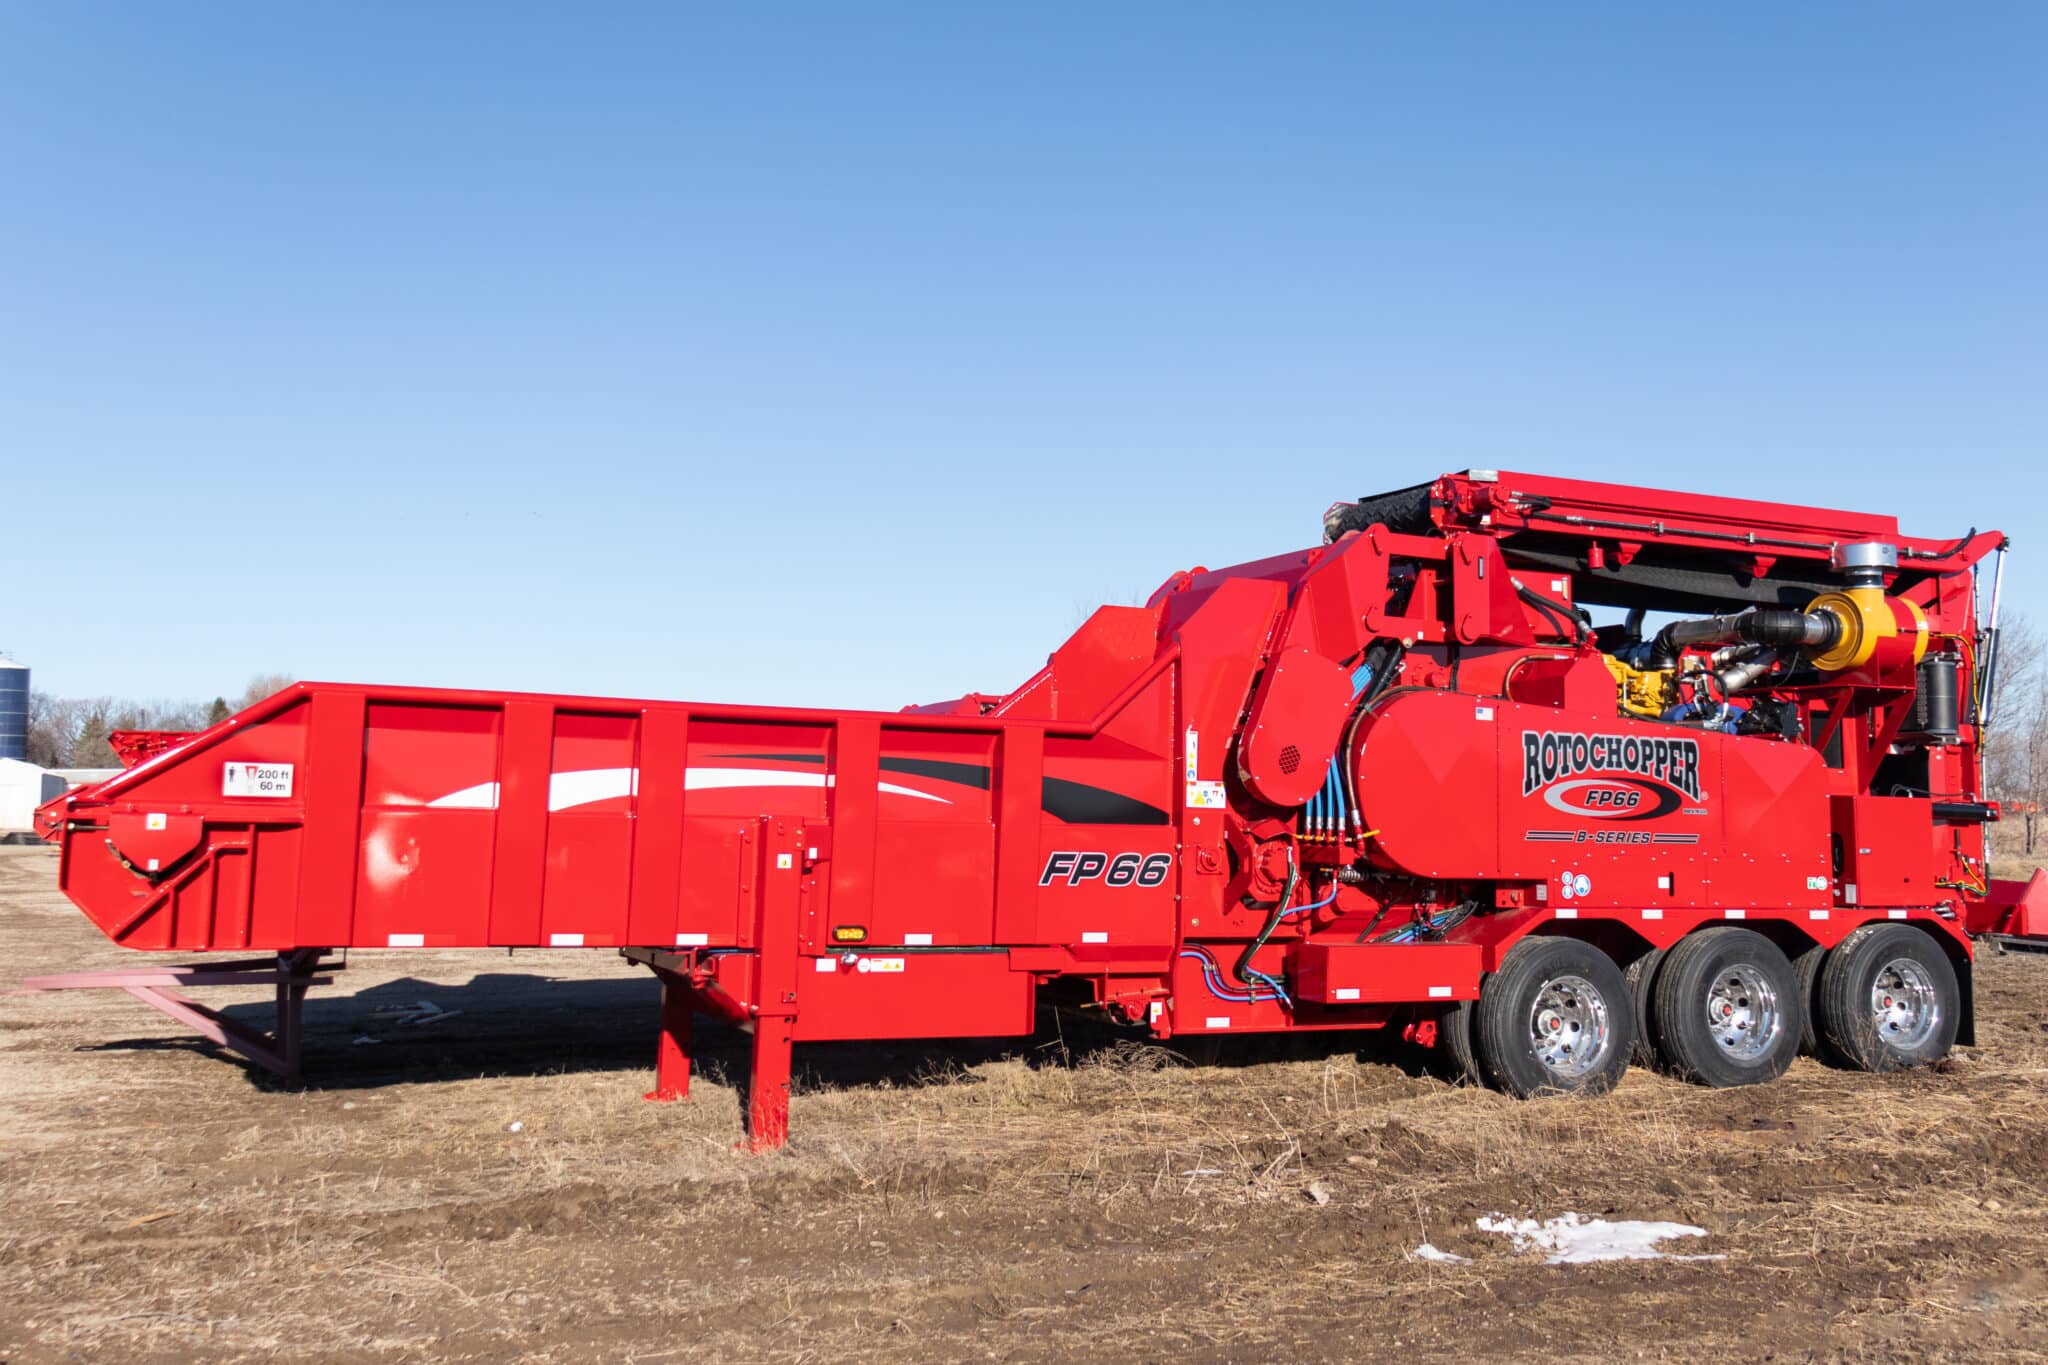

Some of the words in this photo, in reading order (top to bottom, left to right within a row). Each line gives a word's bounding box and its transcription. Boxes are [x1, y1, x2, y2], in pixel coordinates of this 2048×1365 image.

[258, 769, 278, 779] 200
[281, 770, 289, 779] ft
[1522, 730, 1701, 803] ROTOCHOPPER
[260, 781, 273, 790] 60
[1584, 790, 1640, 807] FP66
[1576, 830, 1651, 844] B-SERIES
[1038, 851, 1172, 887] FP66
